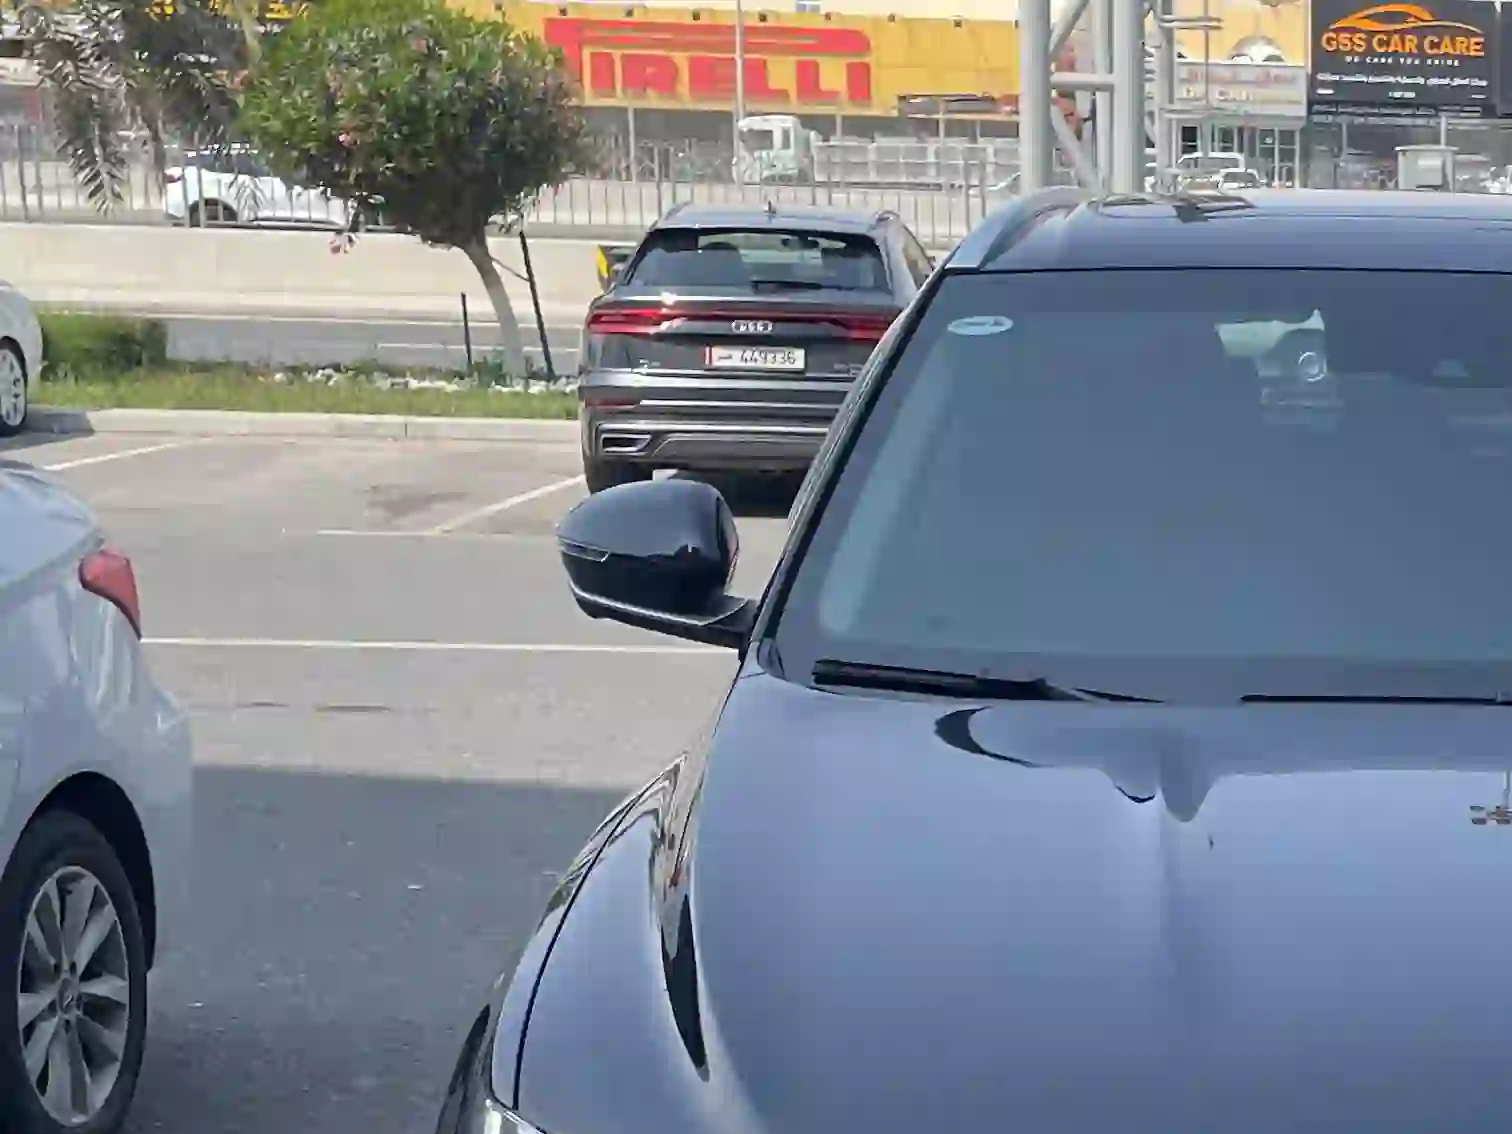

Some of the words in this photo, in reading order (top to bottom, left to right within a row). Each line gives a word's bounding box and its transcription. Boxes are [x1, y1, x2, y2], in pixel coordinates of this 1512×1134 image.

[543, 17, 872, 103] PIRELLI
[1321, 31, 1368, 52] GSS
[1372, 33, 1418, 54] CAR
[1423, 35, 1485, 57] CARE
